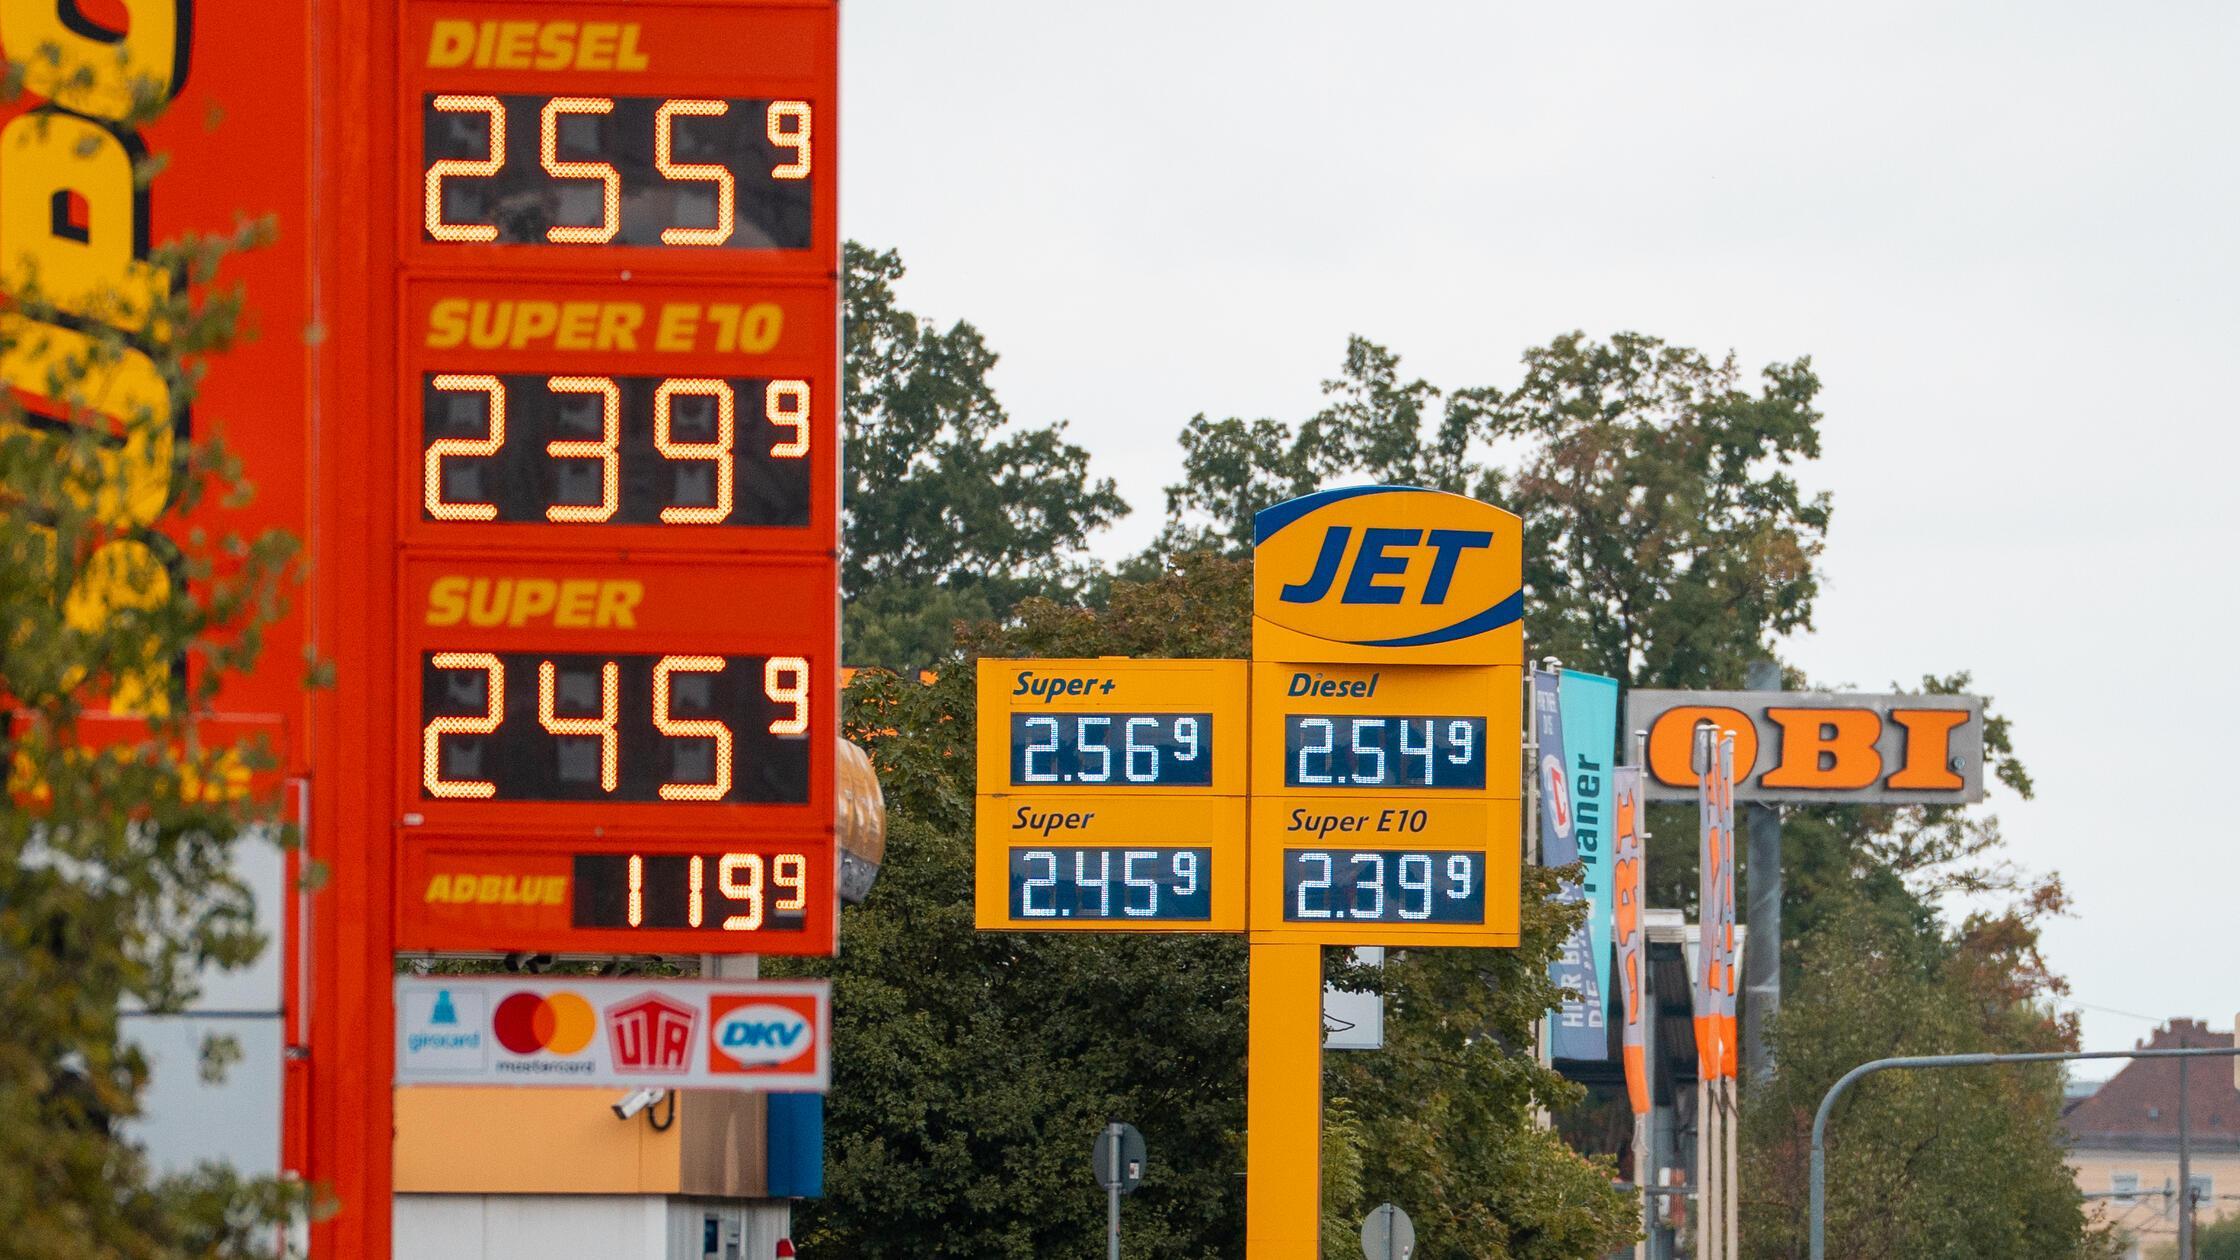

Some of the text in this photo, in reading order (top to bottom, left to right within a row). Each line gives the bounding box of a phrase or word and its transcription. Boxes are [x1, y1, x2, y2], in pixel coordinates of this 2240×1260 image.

[427, 20, 649, 71] DIESEL
[425, 298, 644, 352] SUPER
[1279, 526, 1493, 605] JET
[425, 575, 644, 630] SUPER
[1012, 671, 1115, 704] Super+
[1287, 672, 1380, 698] Diesel
[1649, 704, 1971, 790] OBI
[1012, 806, 1095, 837] Super
[1287, 808, 1427, 839] Super E10
[424, 874, 569, 904] ADBLUE
[612, 1000, 693, 1066] UTA
[722, 1021, 803, 1048] DKV
